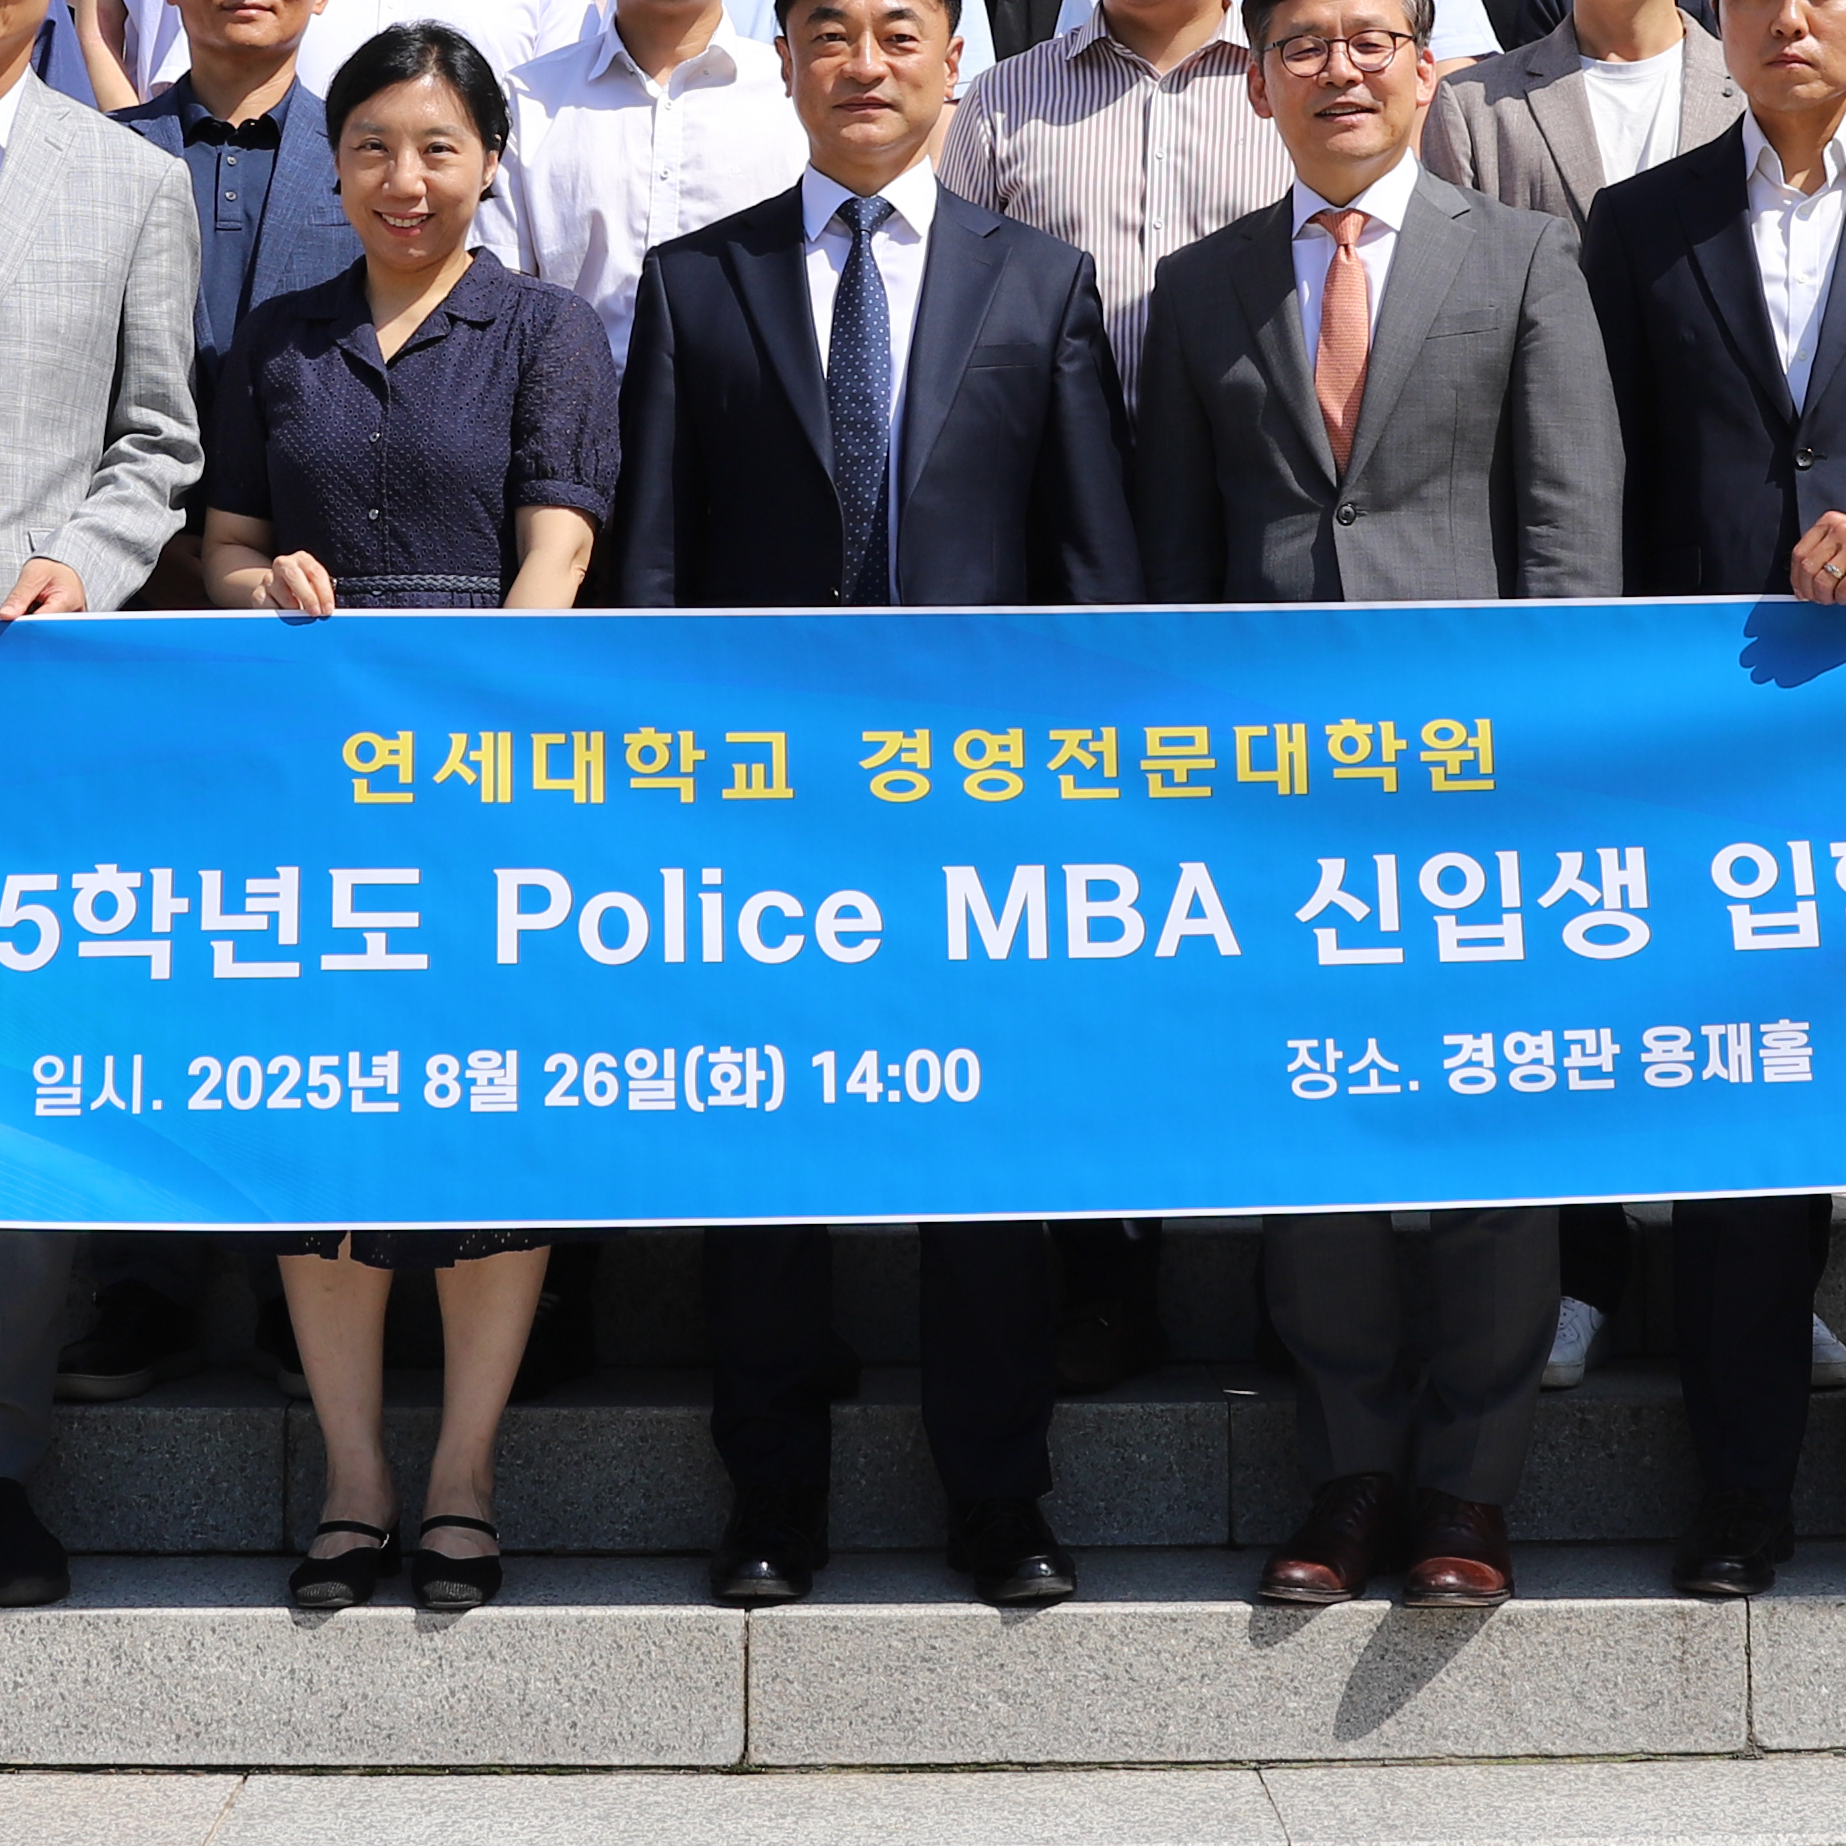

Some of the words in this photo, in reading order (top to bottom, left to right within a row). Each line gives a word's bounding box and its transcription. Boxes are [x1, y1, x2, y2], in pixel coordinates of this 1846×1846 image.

[343, 727, 795, 804] 연세대학교
[857, 718, 1496, 803] 경영전문대학원
[492, 867, 884, 965] Police
[941, 862, 1243, 960] MBA
[1294, 846, 1652, 966] 신입생
[32, 1054, 164, 1117] 일시.
[188, 1050, 401, 1113] 2025년
[423, 1049, 519, 1112] 8월
[543, 1044, 786, 1113] 26일(화)
[812, 1048, 981, 1104] 14:00
[1285, 1037, 1421, 1100] 장소.
[1443, 1027, 1622, 1095] 경영관
[1640, 1018, 1814, 1088] 용재홀
